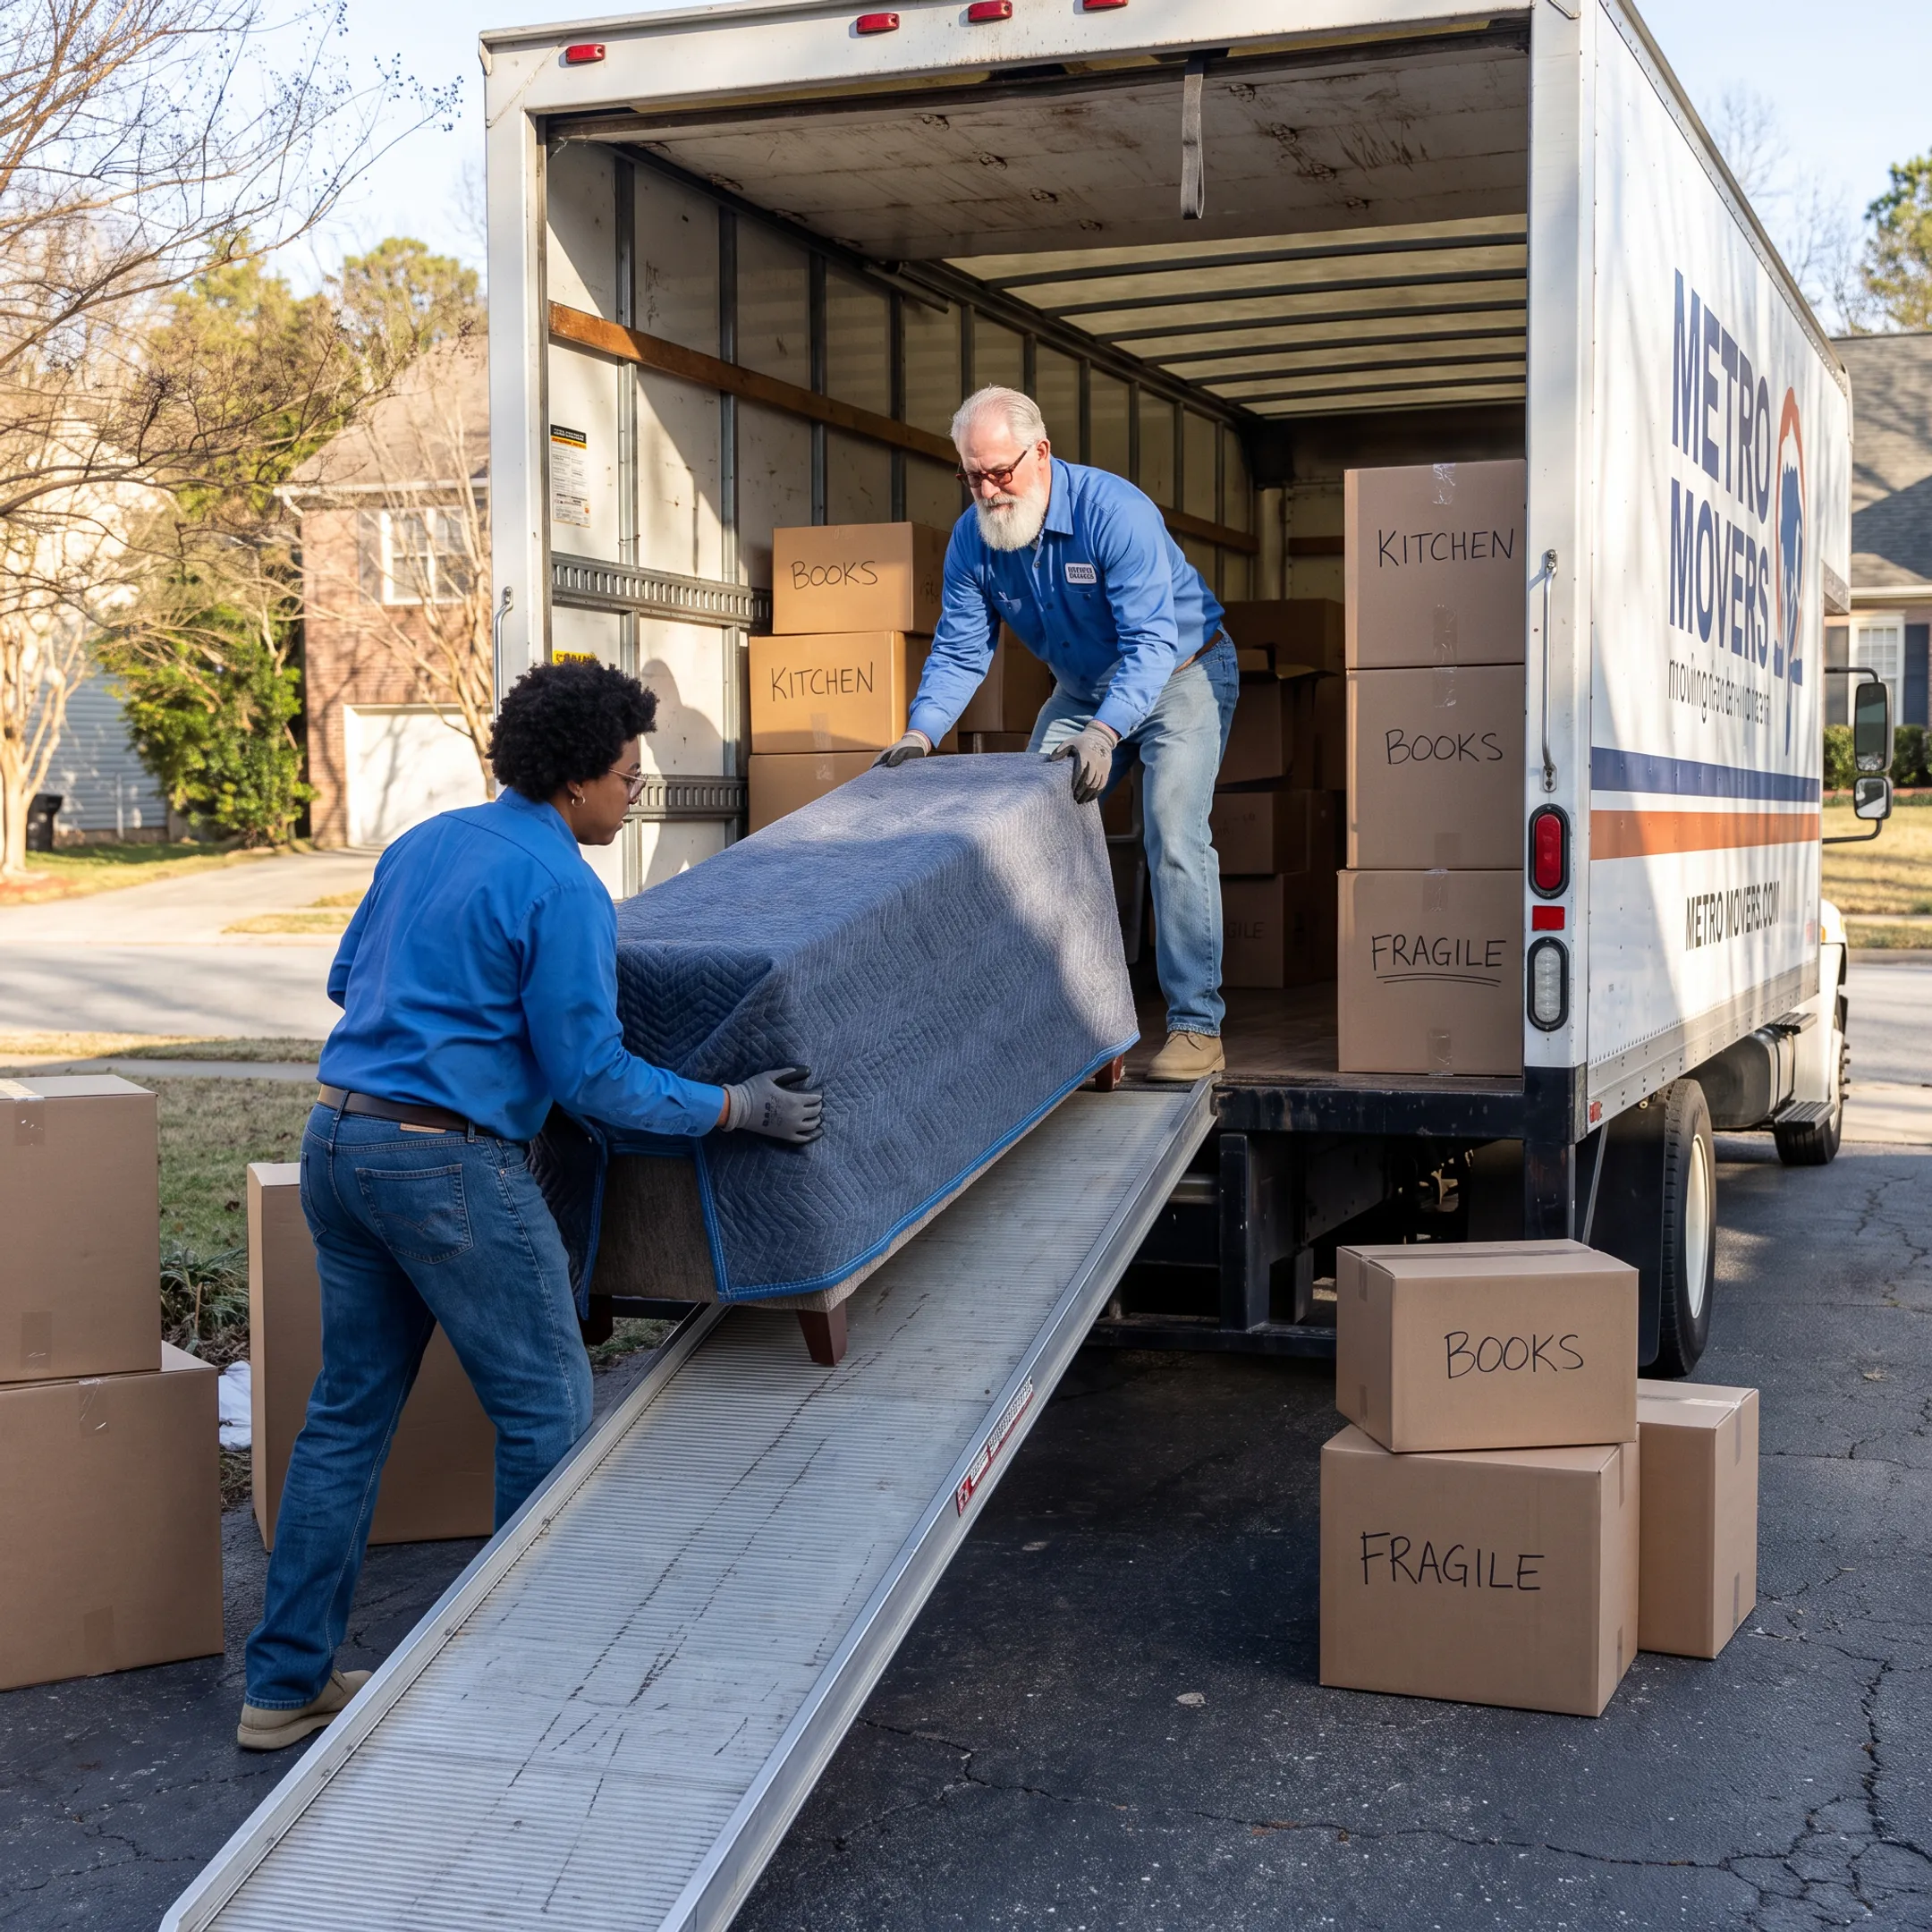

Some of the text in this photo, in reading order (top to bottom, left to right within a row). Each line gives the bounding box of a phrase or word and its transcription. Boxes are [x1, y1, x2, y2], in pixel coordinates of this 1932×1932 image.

[1672, 267, 1771, 525] METRO
[1378, 529, 1514, 568] KITCHEN
[791, 560, 878, 590] BOOKS
[1669, 477, 1769, 669] MOVERS
[771, 661, 874, 702] KITCHEN
[1385, 728, 1504, 766] BOOKS
[1225, 921, 1266, 940] GILE
[1685, 880, 1780, 951] METRO MOVERS.COM
[1371, 933, 1507, 971] FRAGILE
[1444, 1330, 1584, 1379] BOOKS
[1360, 1530, 1546, 1591] FRAGILE
